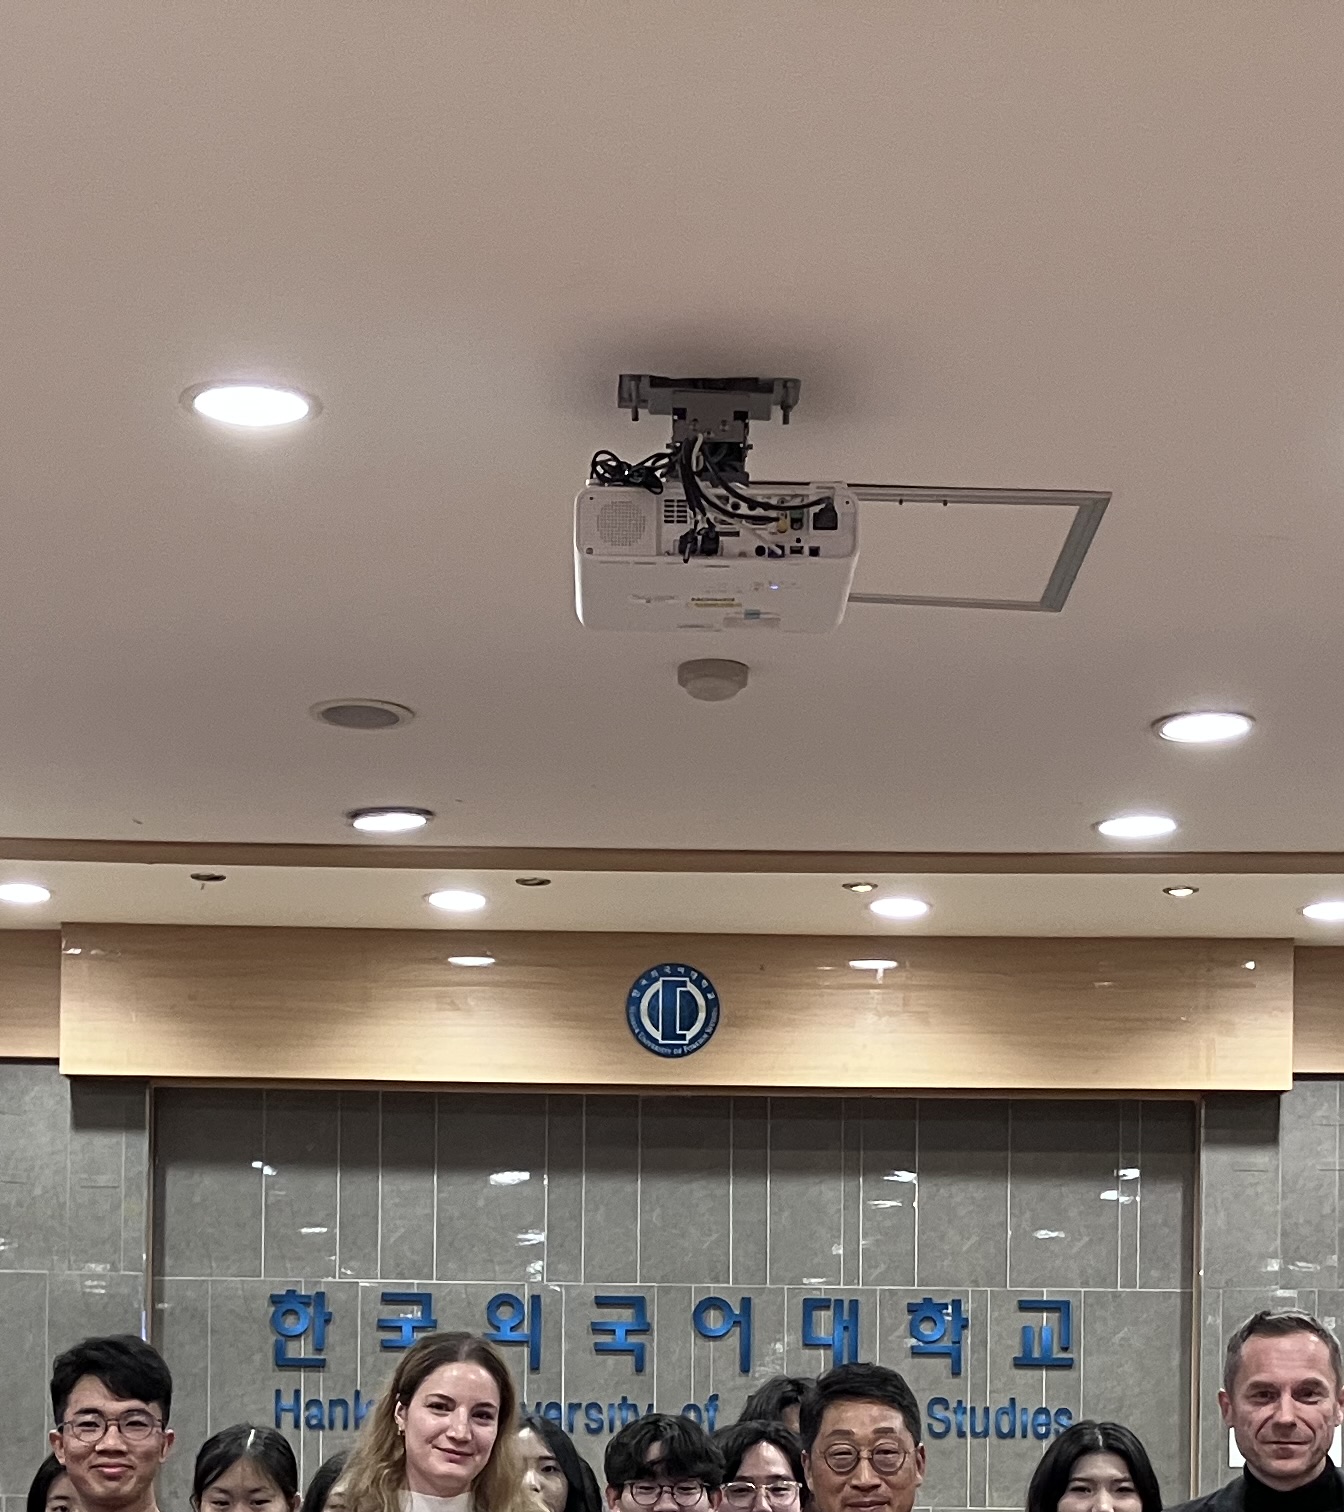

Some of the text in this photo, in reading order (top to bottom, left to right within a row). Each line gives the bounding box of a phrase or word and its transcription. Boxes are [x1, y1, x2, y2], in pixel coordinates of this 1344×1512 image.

[271, 1290, 1073, 1375] 한국외국어대학교
[274, 1388, 375, 1431] Hank
[926, 1396, 1073, 1441] Studies
